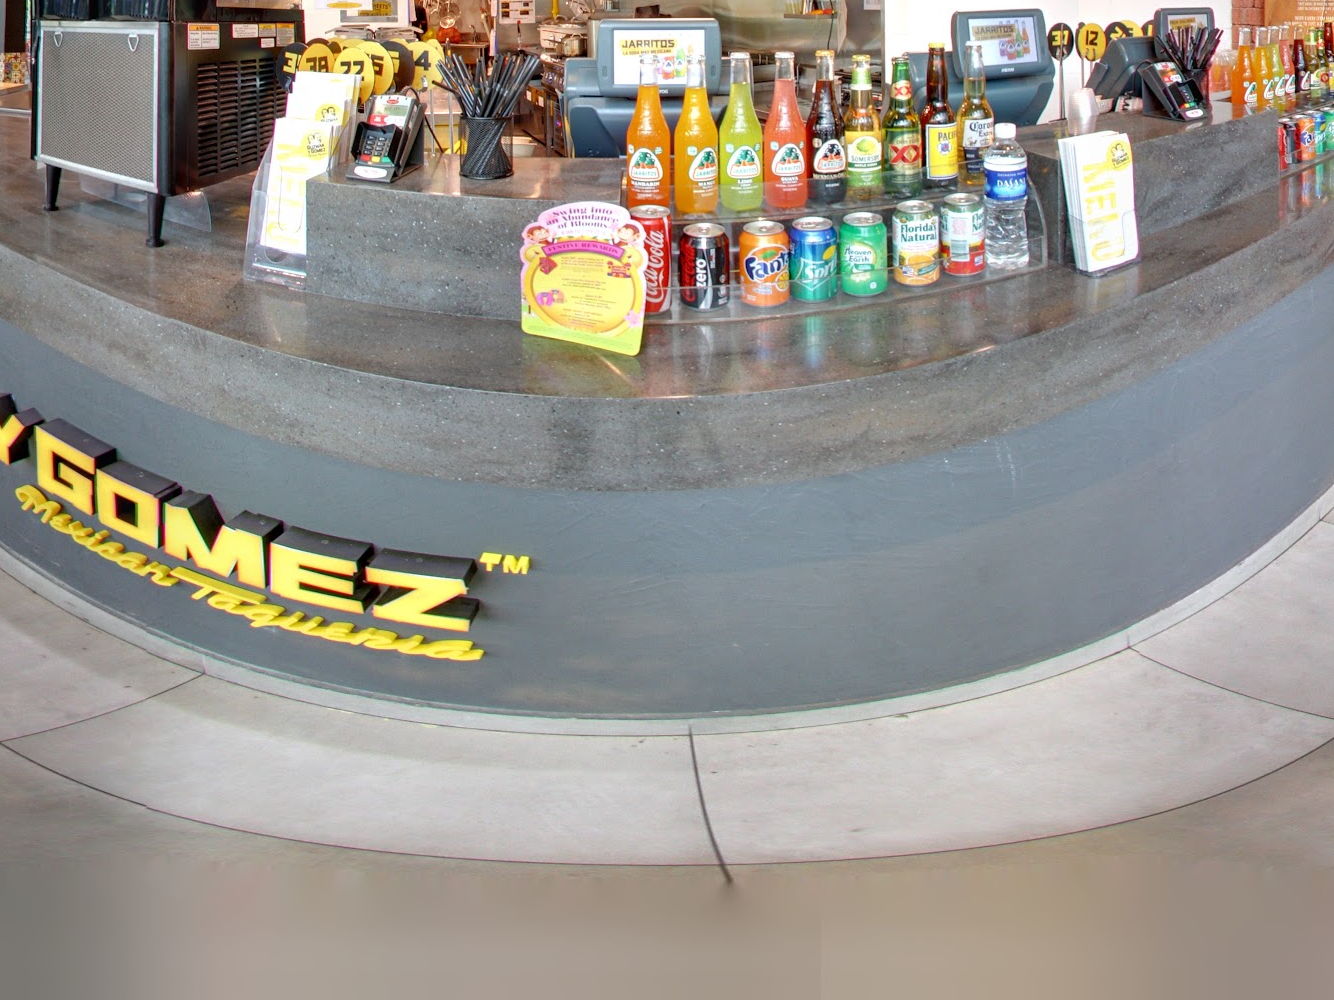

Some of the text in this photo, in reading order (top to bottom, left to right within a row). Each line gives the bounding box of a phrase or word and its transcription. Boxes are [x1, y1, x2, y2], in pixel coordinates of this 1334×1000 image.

[974, 26, 1014, 35] JARRITOS
[622, 39, 675, 48] JARRITOS
[1085, 30, 1099, 47] 12
[851, 154, 880, 162] SOMERSBY
[821, 161, 844, 169] JARRITOS
[996, 177, 1026, 188] DASANI
[552, 206, 613, 217] Swing into
[562, 213, 619, 223] Abundance
[570, 220, 608, 228] Blooms
[900, 231, 937, 243] Natural
[548, 242, 618, 254] FESTIVE REWARDS
[845, 243, 873, 256] Heaven
[849, 255, 871, 263] Earth
[696, 258, 707, 289] zero
[35, 420, 473, 632] GOMEZ
[479, 551, 531, 576] TM
[14, 483, 485, 662] Mexican Taqueria
